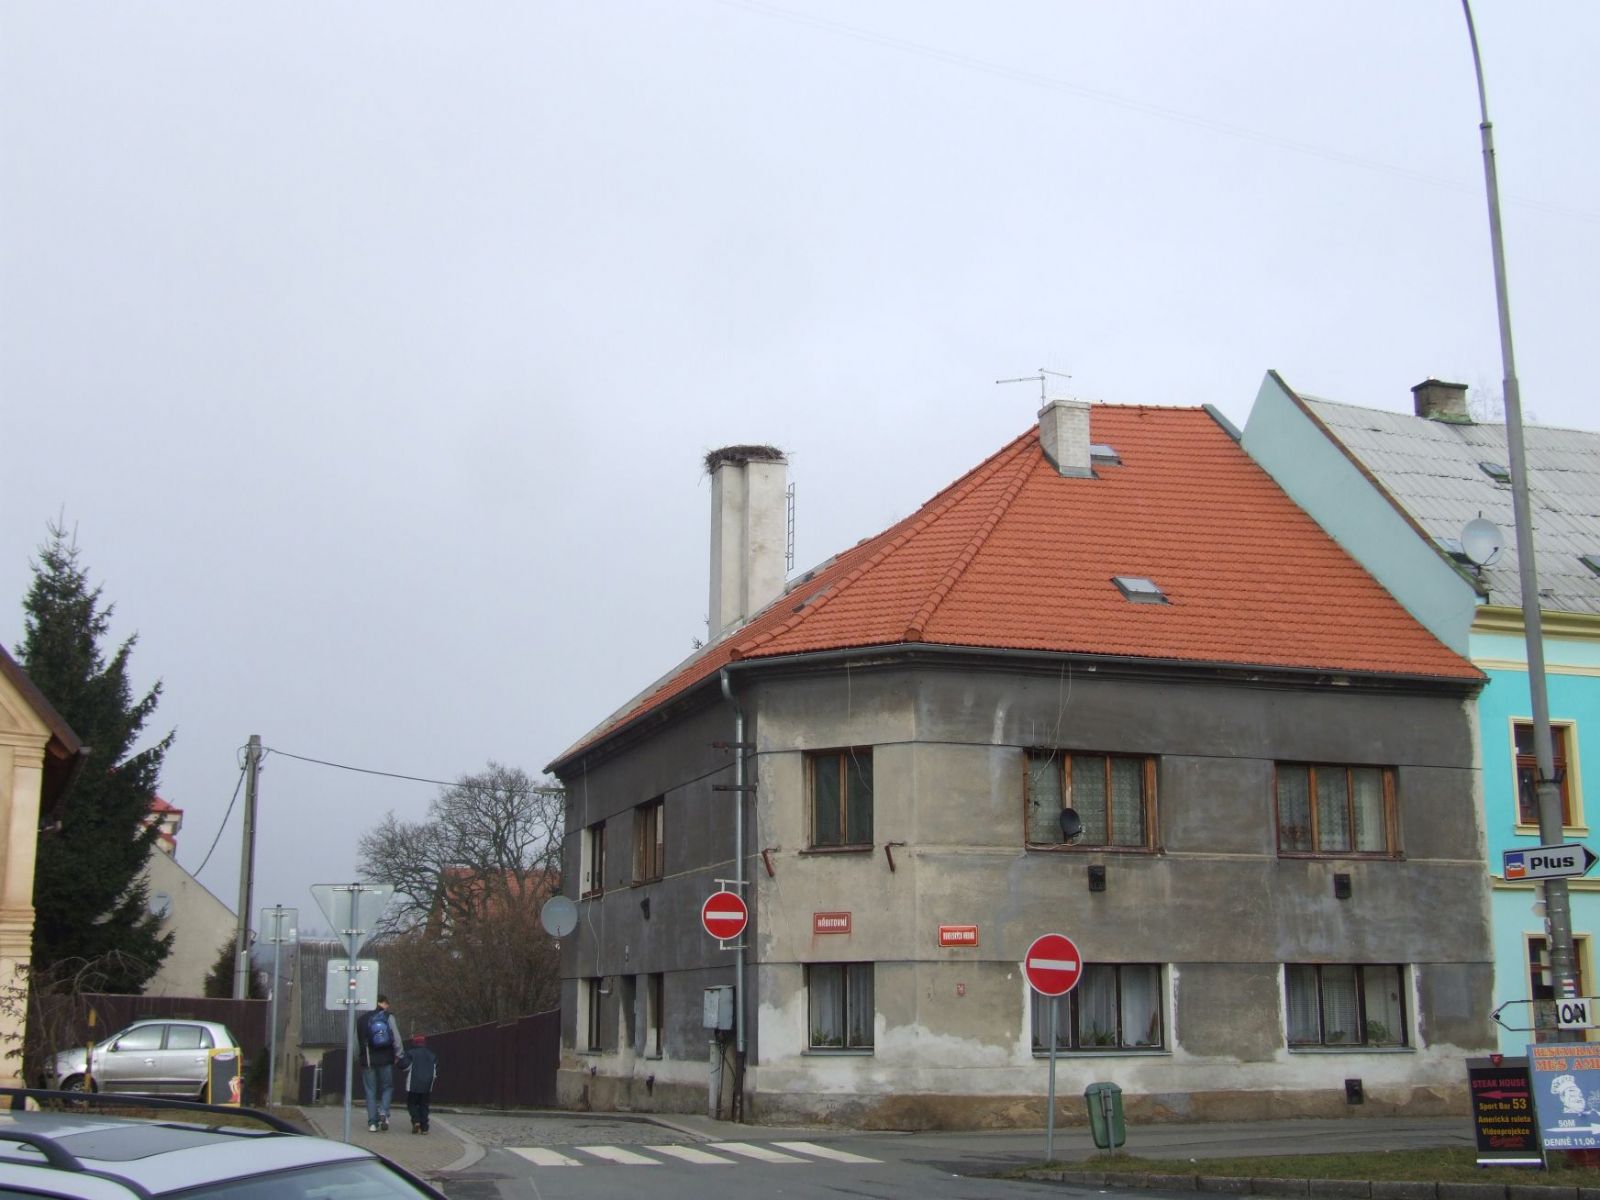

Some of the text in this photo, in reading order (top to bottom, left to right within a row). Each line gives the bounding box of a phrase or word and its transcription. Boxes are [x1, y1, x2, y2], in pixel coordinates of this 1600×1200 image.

[1530, 856, 1575, 870] Plus
[1472, 1079, 1527, 1088] STEAK HOUSE
[1512, 1098, 1527, 1110] 53
